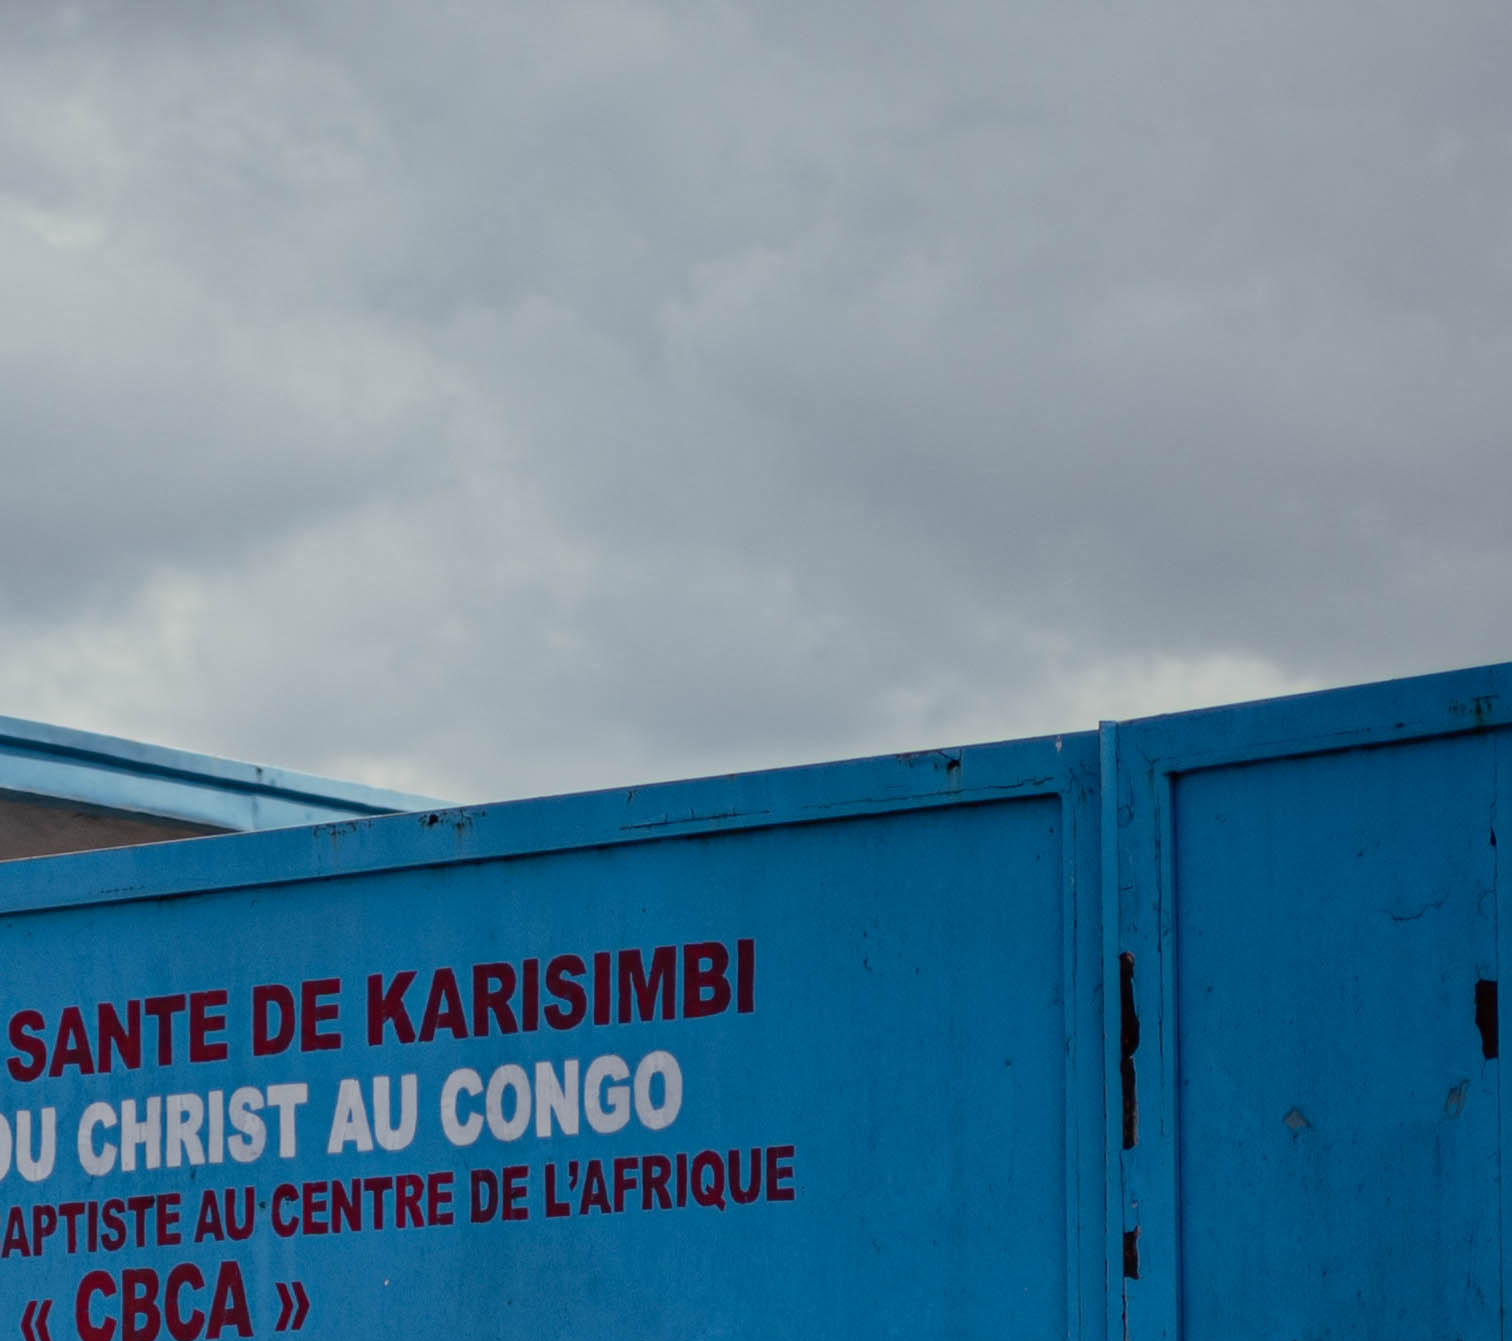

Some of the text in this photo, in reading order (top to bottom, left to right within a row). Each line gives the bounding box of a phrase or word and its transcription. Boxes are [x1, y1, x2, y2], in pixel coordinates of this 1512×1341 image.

[6, 990, 228, 1082] SANTE
[252, 978, 341, 1056] DE
[367, 938, 755, 1048] KARISIMBI
[77, 1082, 308, 1178] CHRIST
[327, 1072, 418, 1155] AU
[440, 1050, 684, 1147] CONGO
[195, 1187, 256, 1244] AU
[271, 1171, 454, 1238] CENTRE
[470, 1166, 529, 1224] DE
[544, 1145, 796, 1219] L'AFRIQUE
